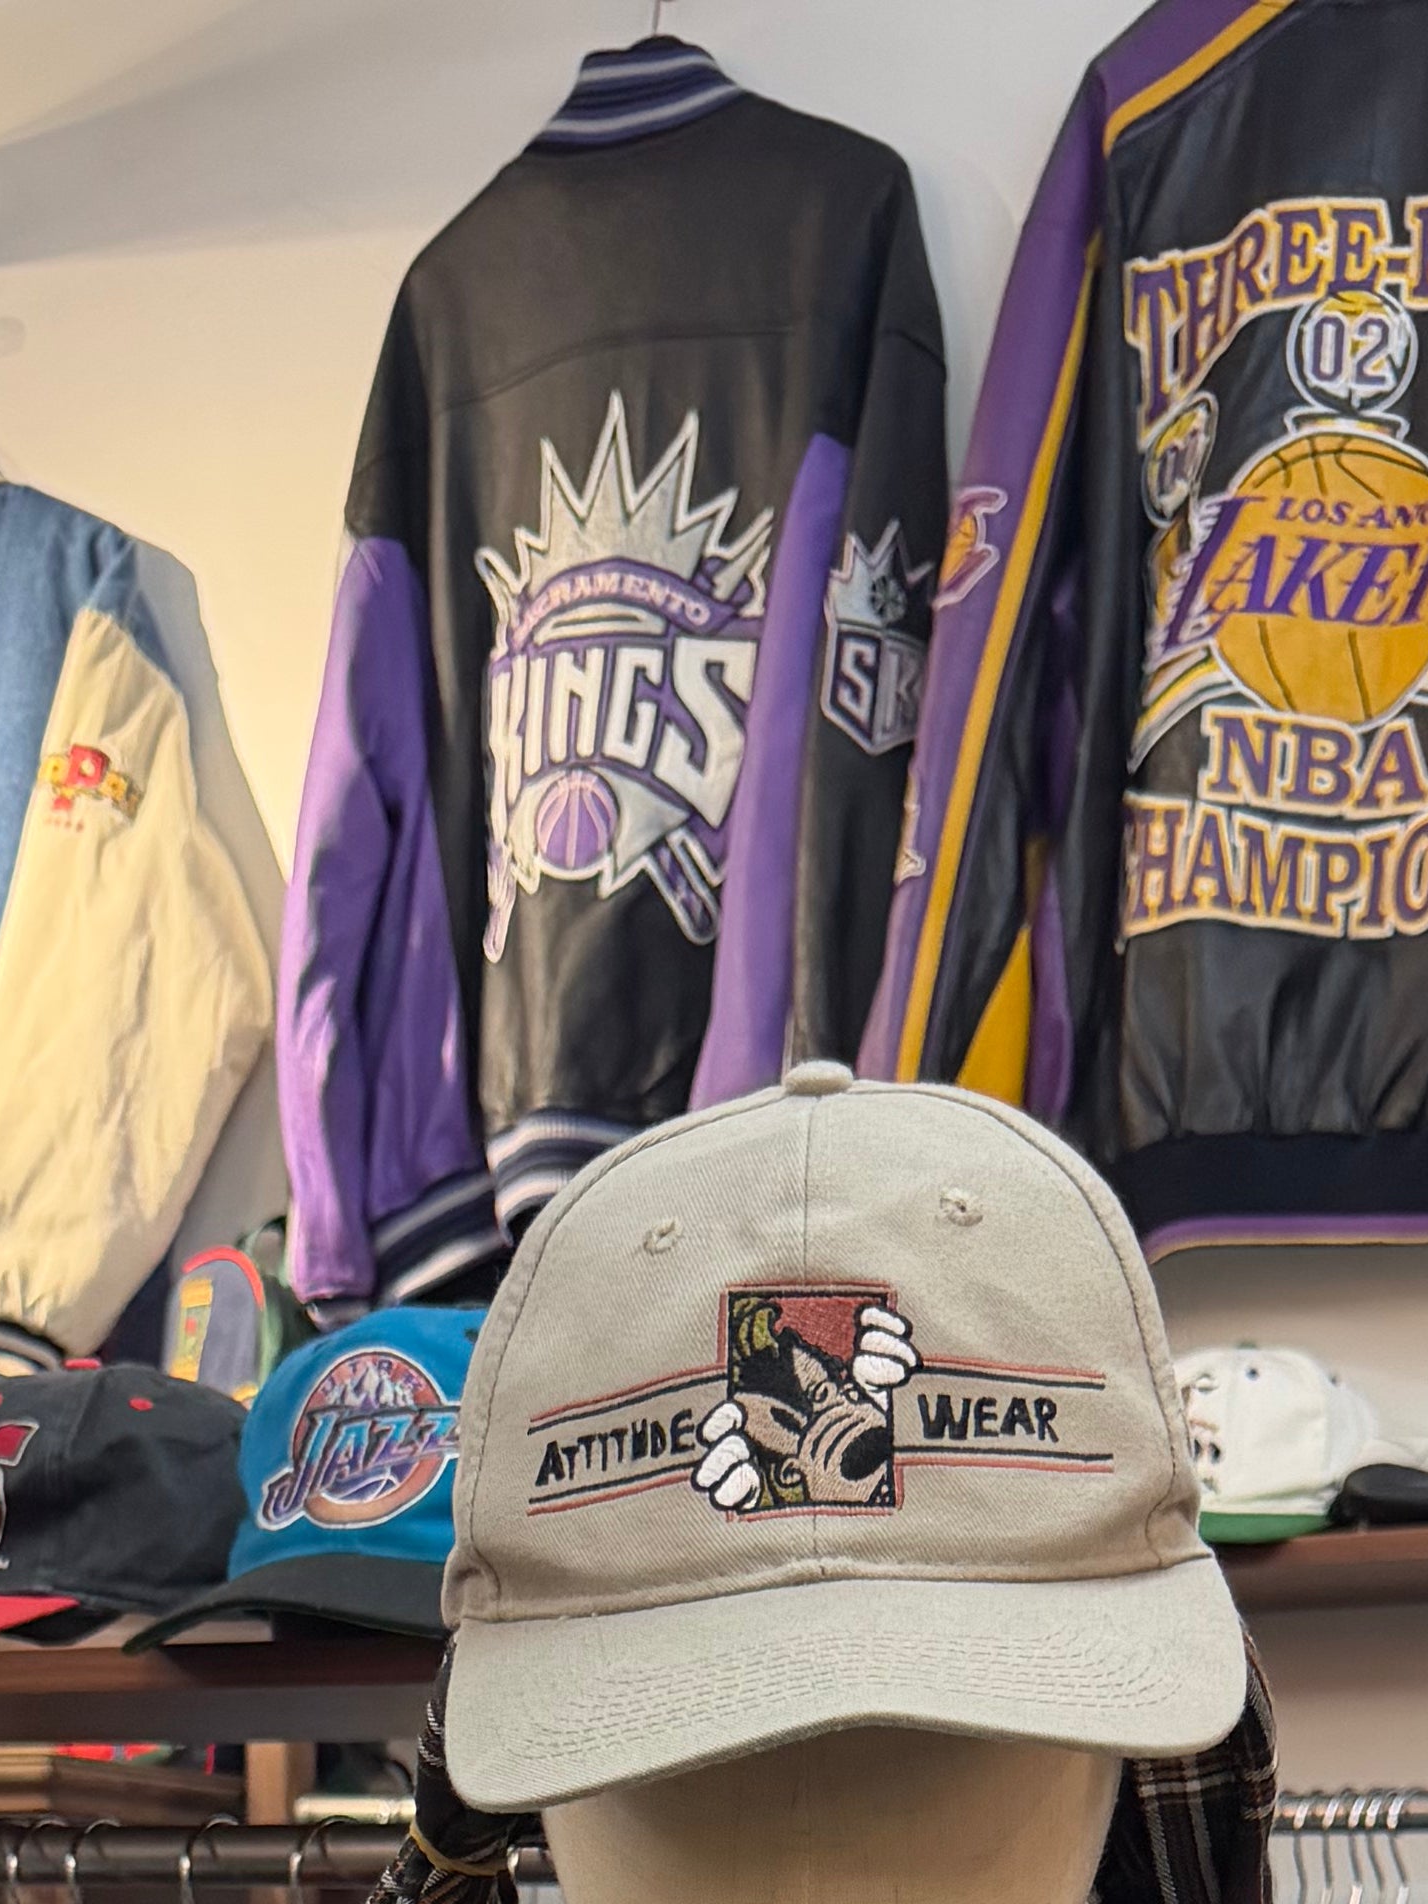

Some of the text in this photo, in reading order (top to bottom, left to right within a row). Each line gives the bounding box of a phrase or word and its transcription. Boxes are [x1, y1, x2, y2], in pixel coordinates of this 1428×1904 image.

[1310, 312, 1396, 392] 02
[1275, 496, 1352, 530] LOS
[489, 636, 758, 830] KINGS
[534, 1392, 1060, 1487] ATTITUDE WEAR
